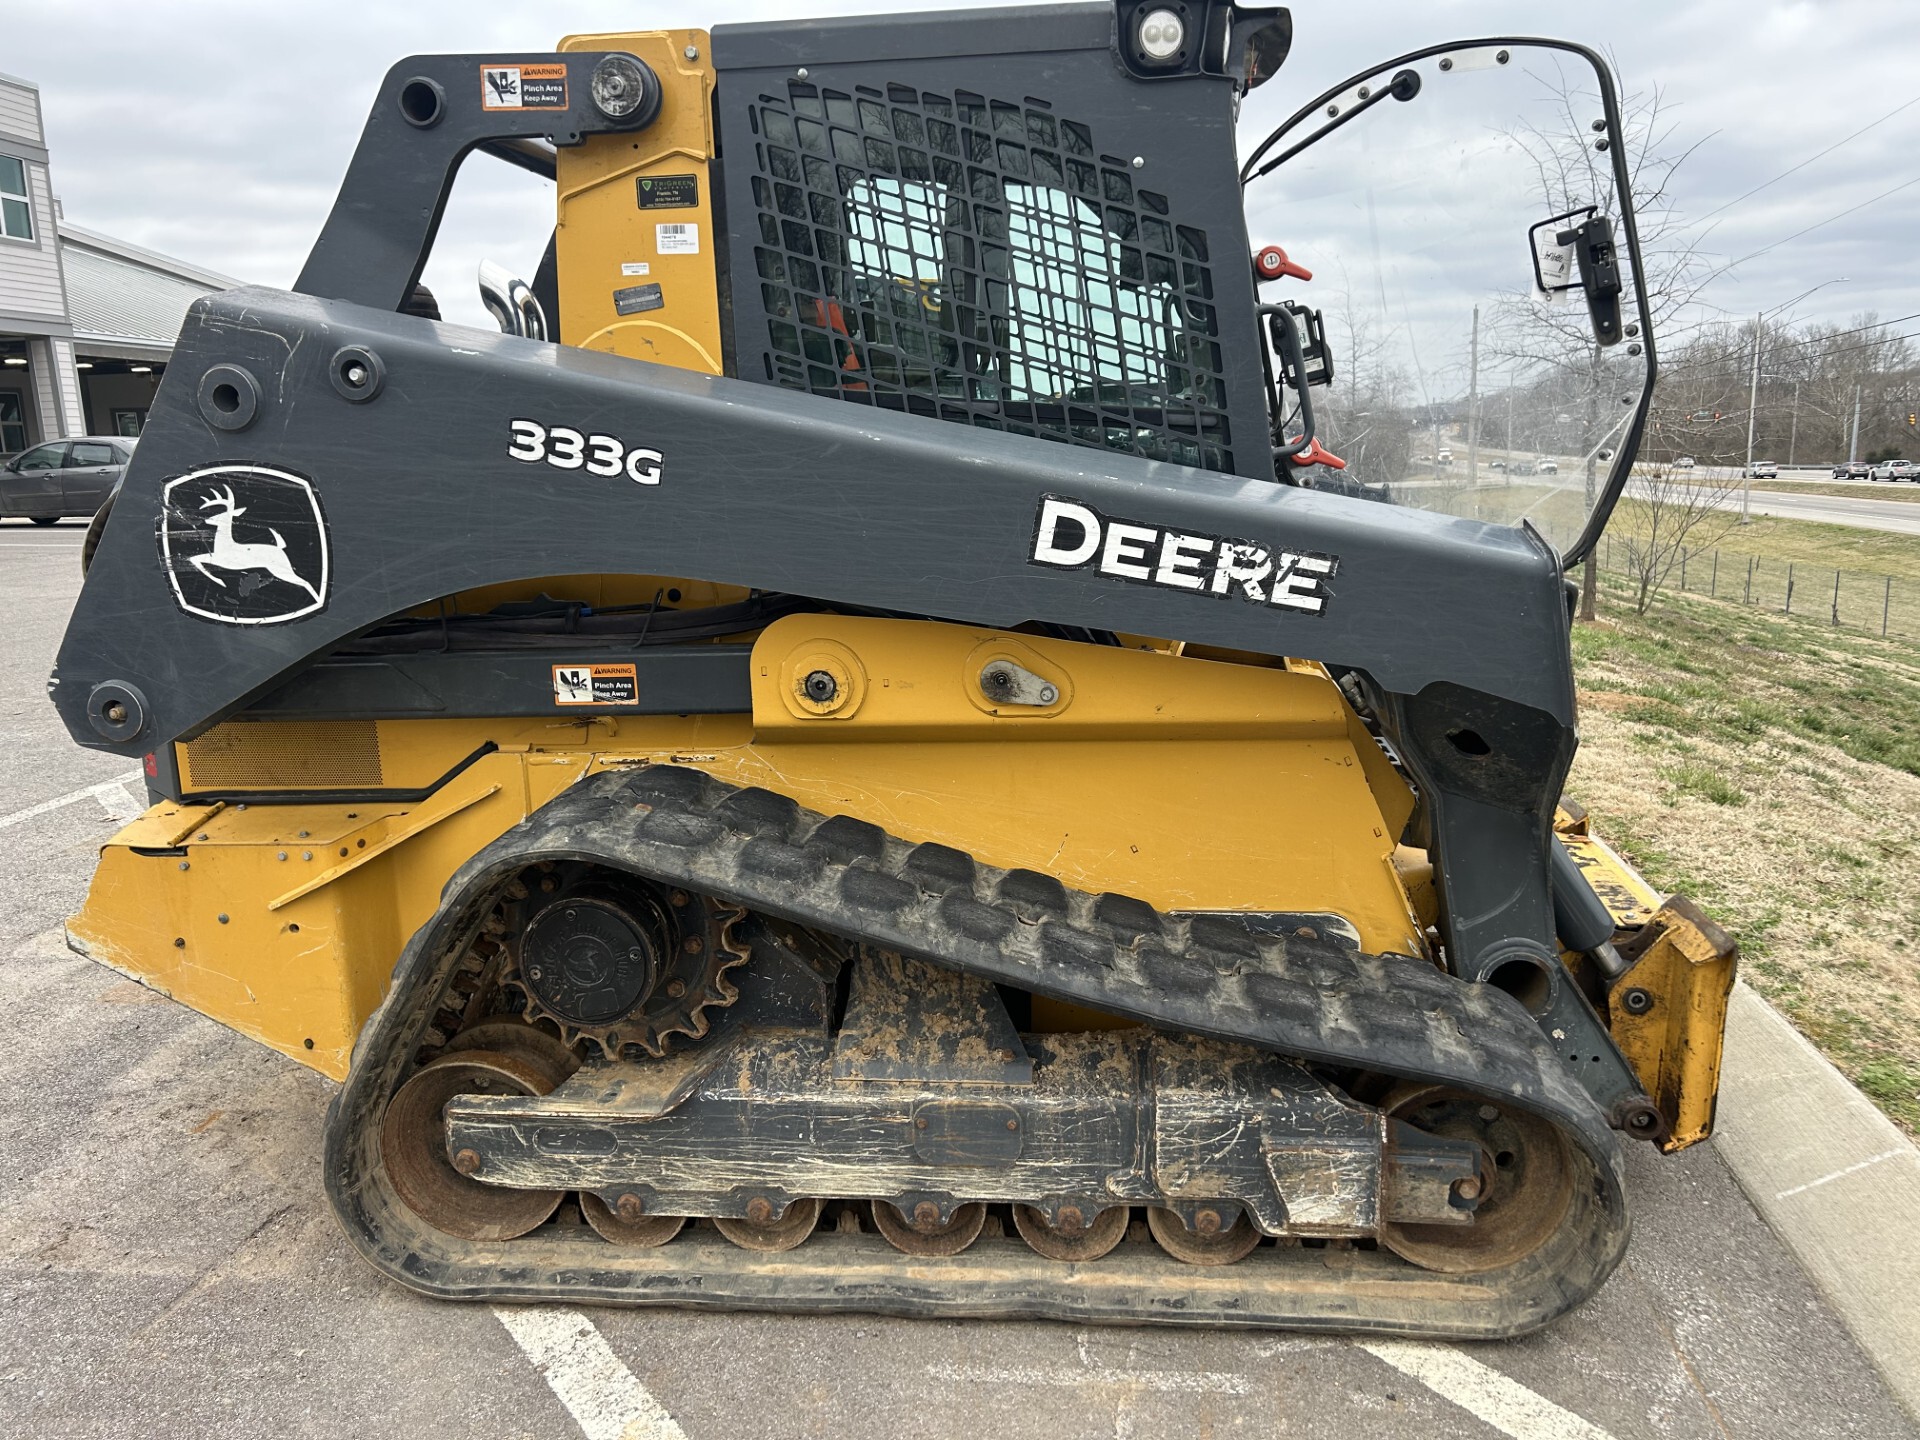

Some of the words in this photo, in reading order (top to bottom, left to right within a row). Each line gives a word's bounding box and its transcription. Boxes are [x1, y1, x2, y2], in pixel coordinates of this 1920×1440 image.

[524, 84, 544, 92] Pinch
[545, 84, 563, 92] Area
[541, 95, 558, 103] Away
[508, 419, 662, 485] 333G
[1033, 498, 1332, 611] DEERE
[611, 690, 628, 698] Away
